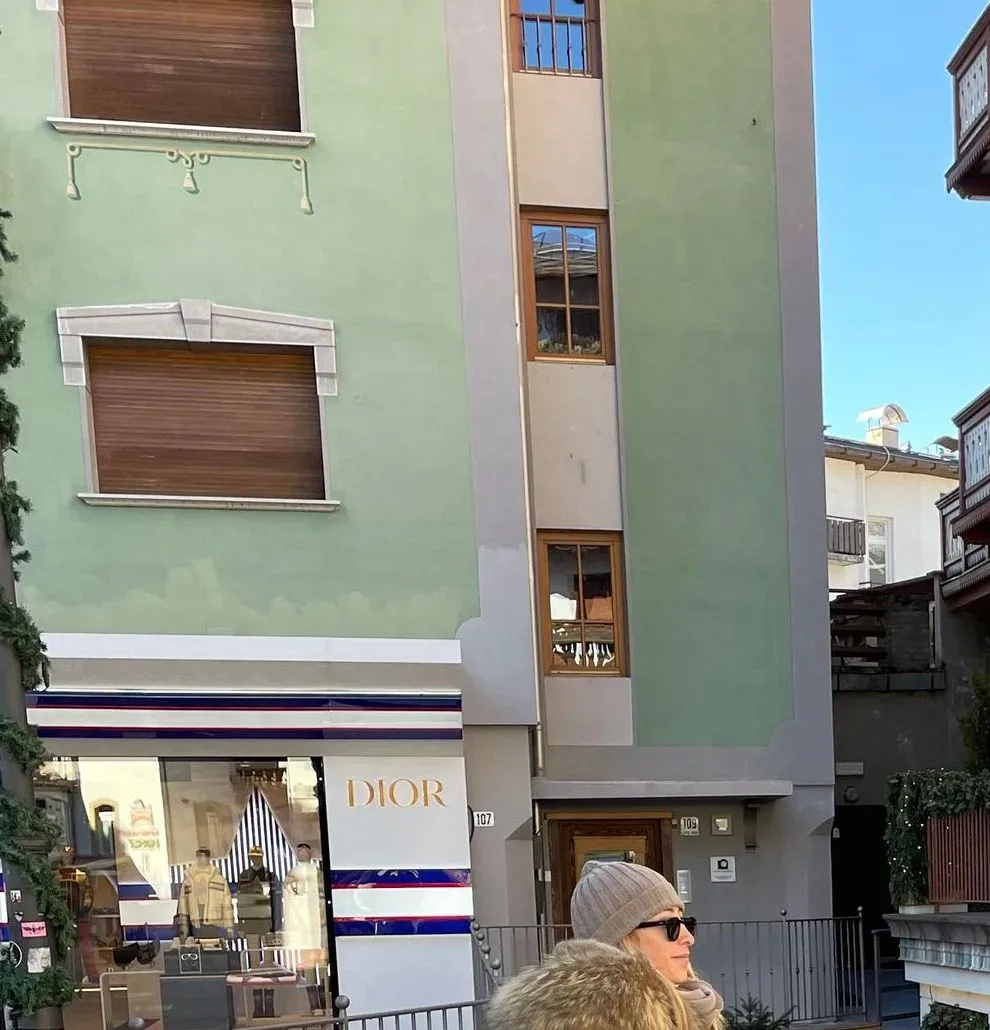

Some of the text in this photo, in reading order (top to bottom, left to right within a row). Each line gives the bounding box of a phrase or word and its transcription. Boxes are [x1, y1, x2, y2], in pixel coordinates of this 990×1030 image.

[346, 778, 448, 808] DIOR
[476, 813, 492, 825] 107
[683, 818, 697, 829] 109
